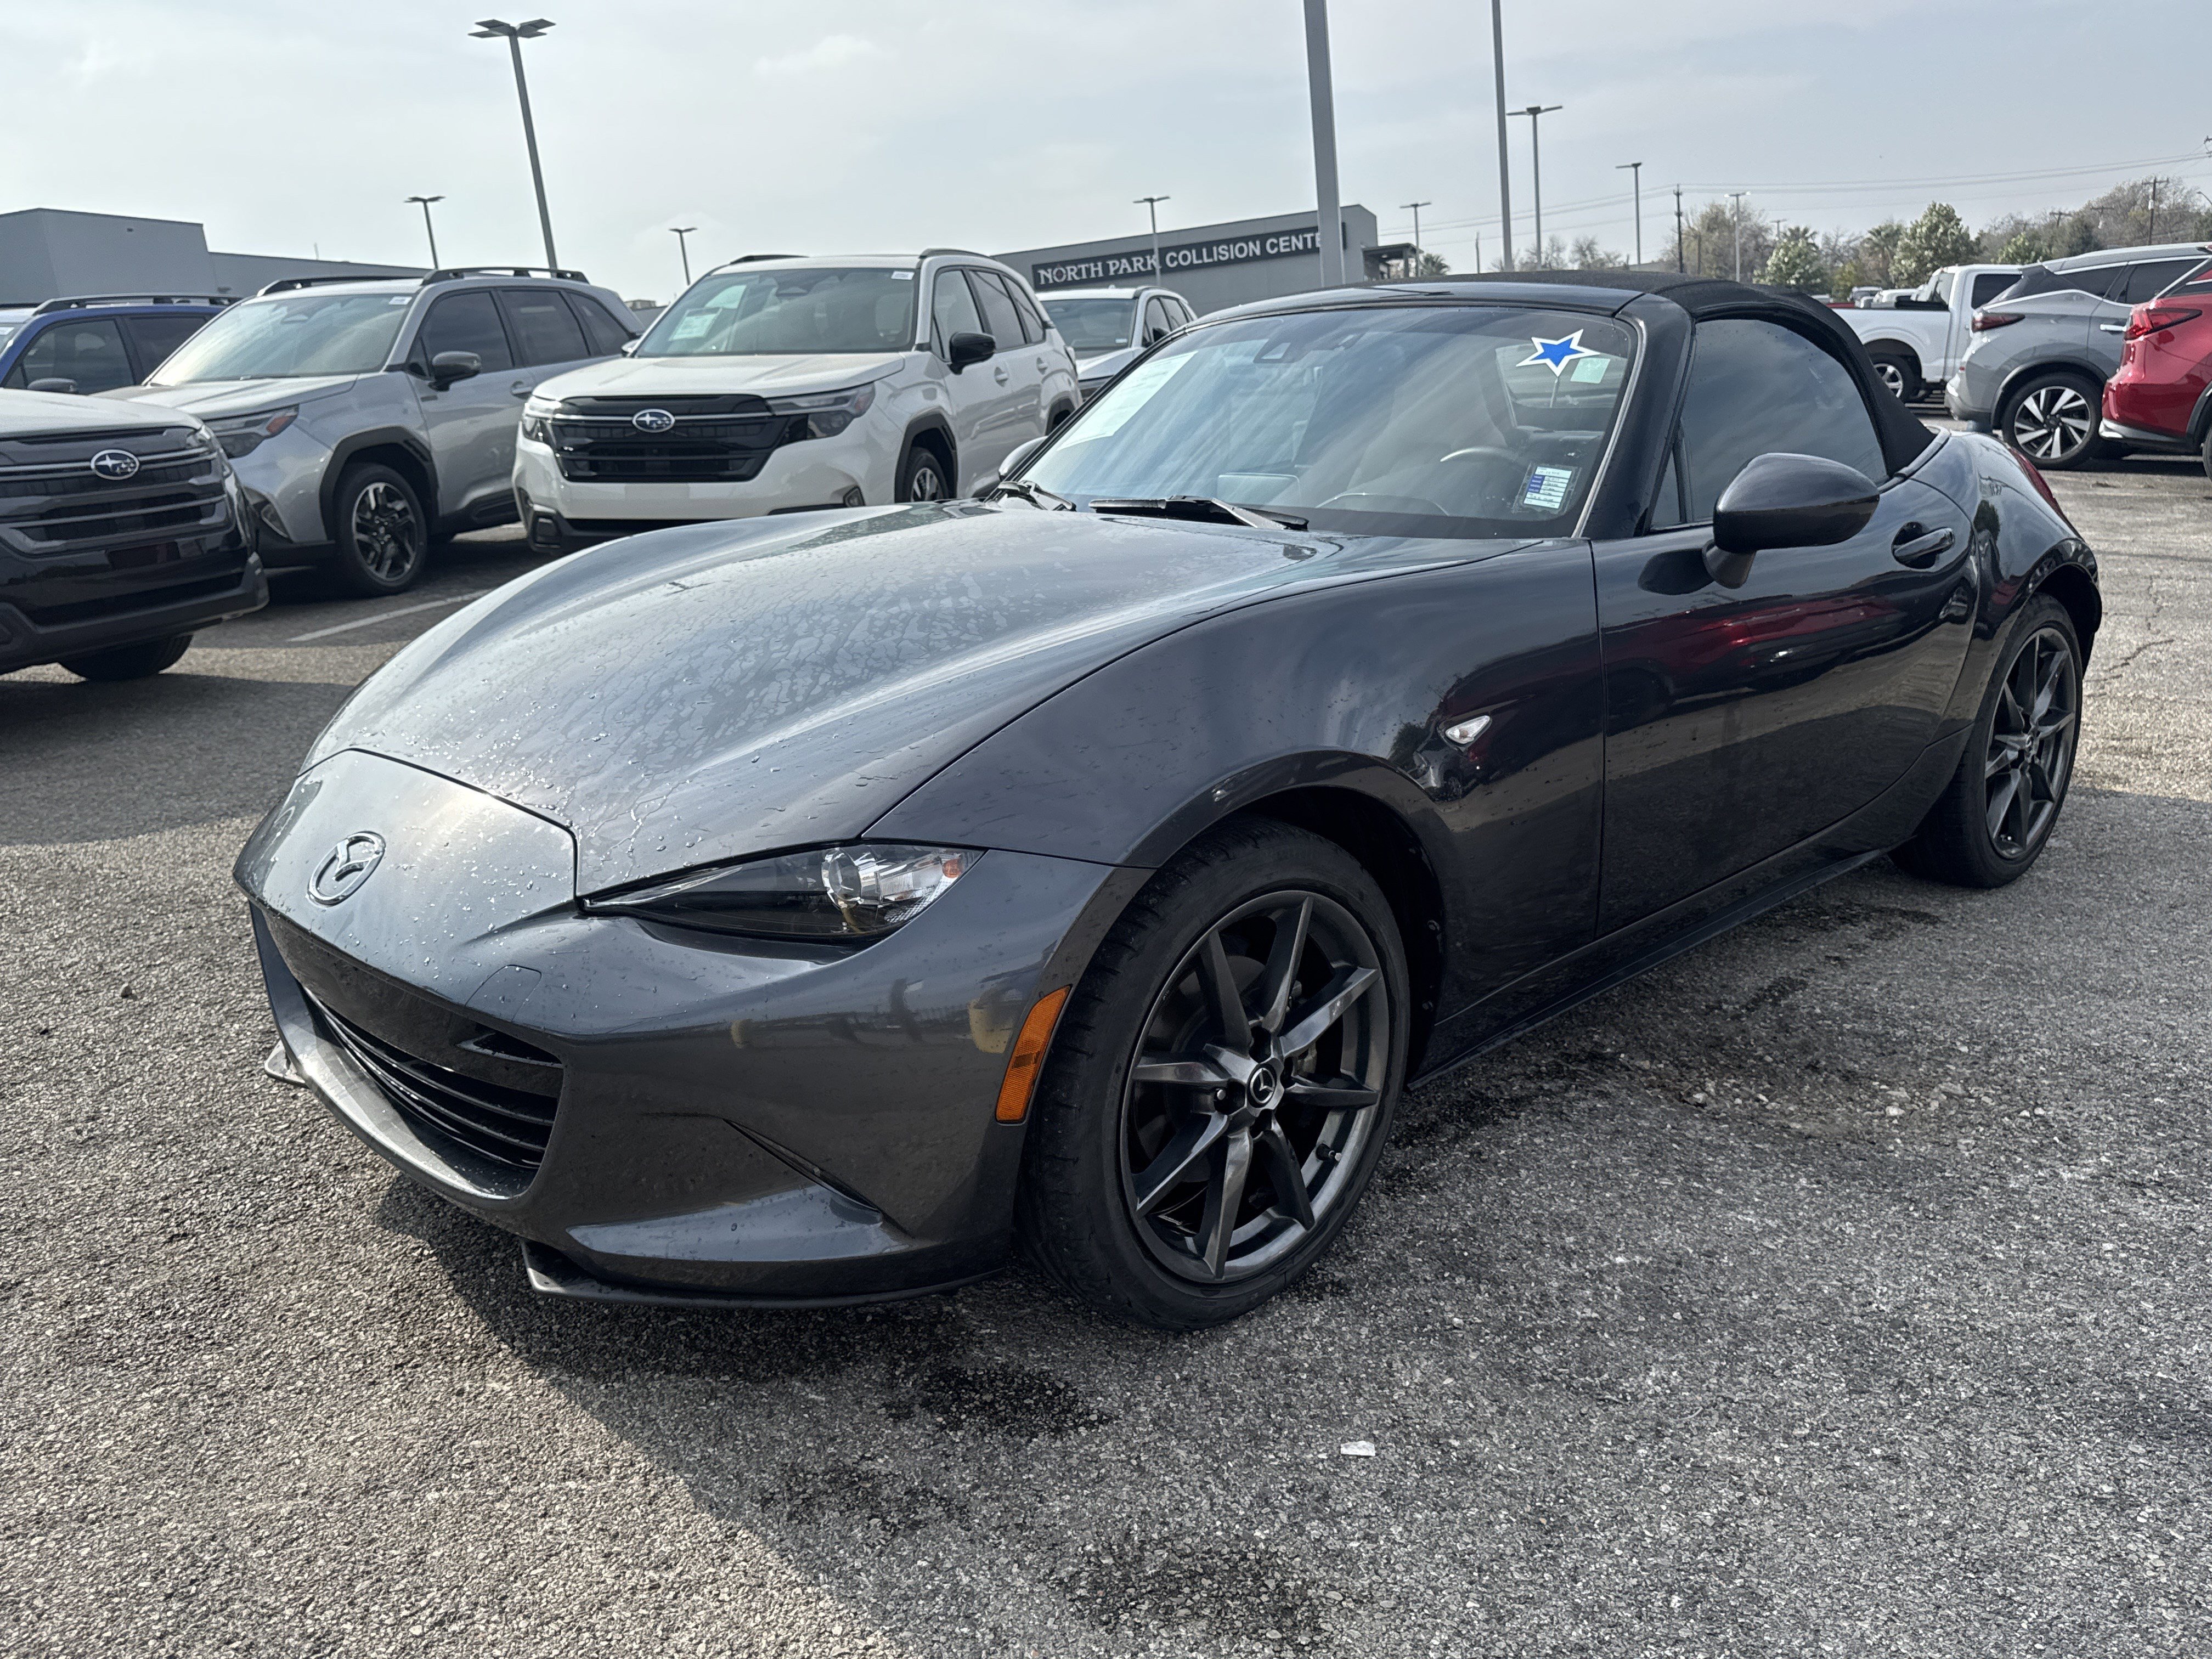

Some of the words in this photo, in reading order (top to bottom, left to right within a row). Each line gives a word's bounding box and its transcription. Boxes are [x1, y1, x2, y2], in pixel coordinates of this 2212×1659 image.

[1037, 261, 1104, 285] NORTH
[1105, 254, 1162, 276] PARK
[1165, 240, 1261, 268] COLLISION
[1265, 232, 1321, 255] CENTE
